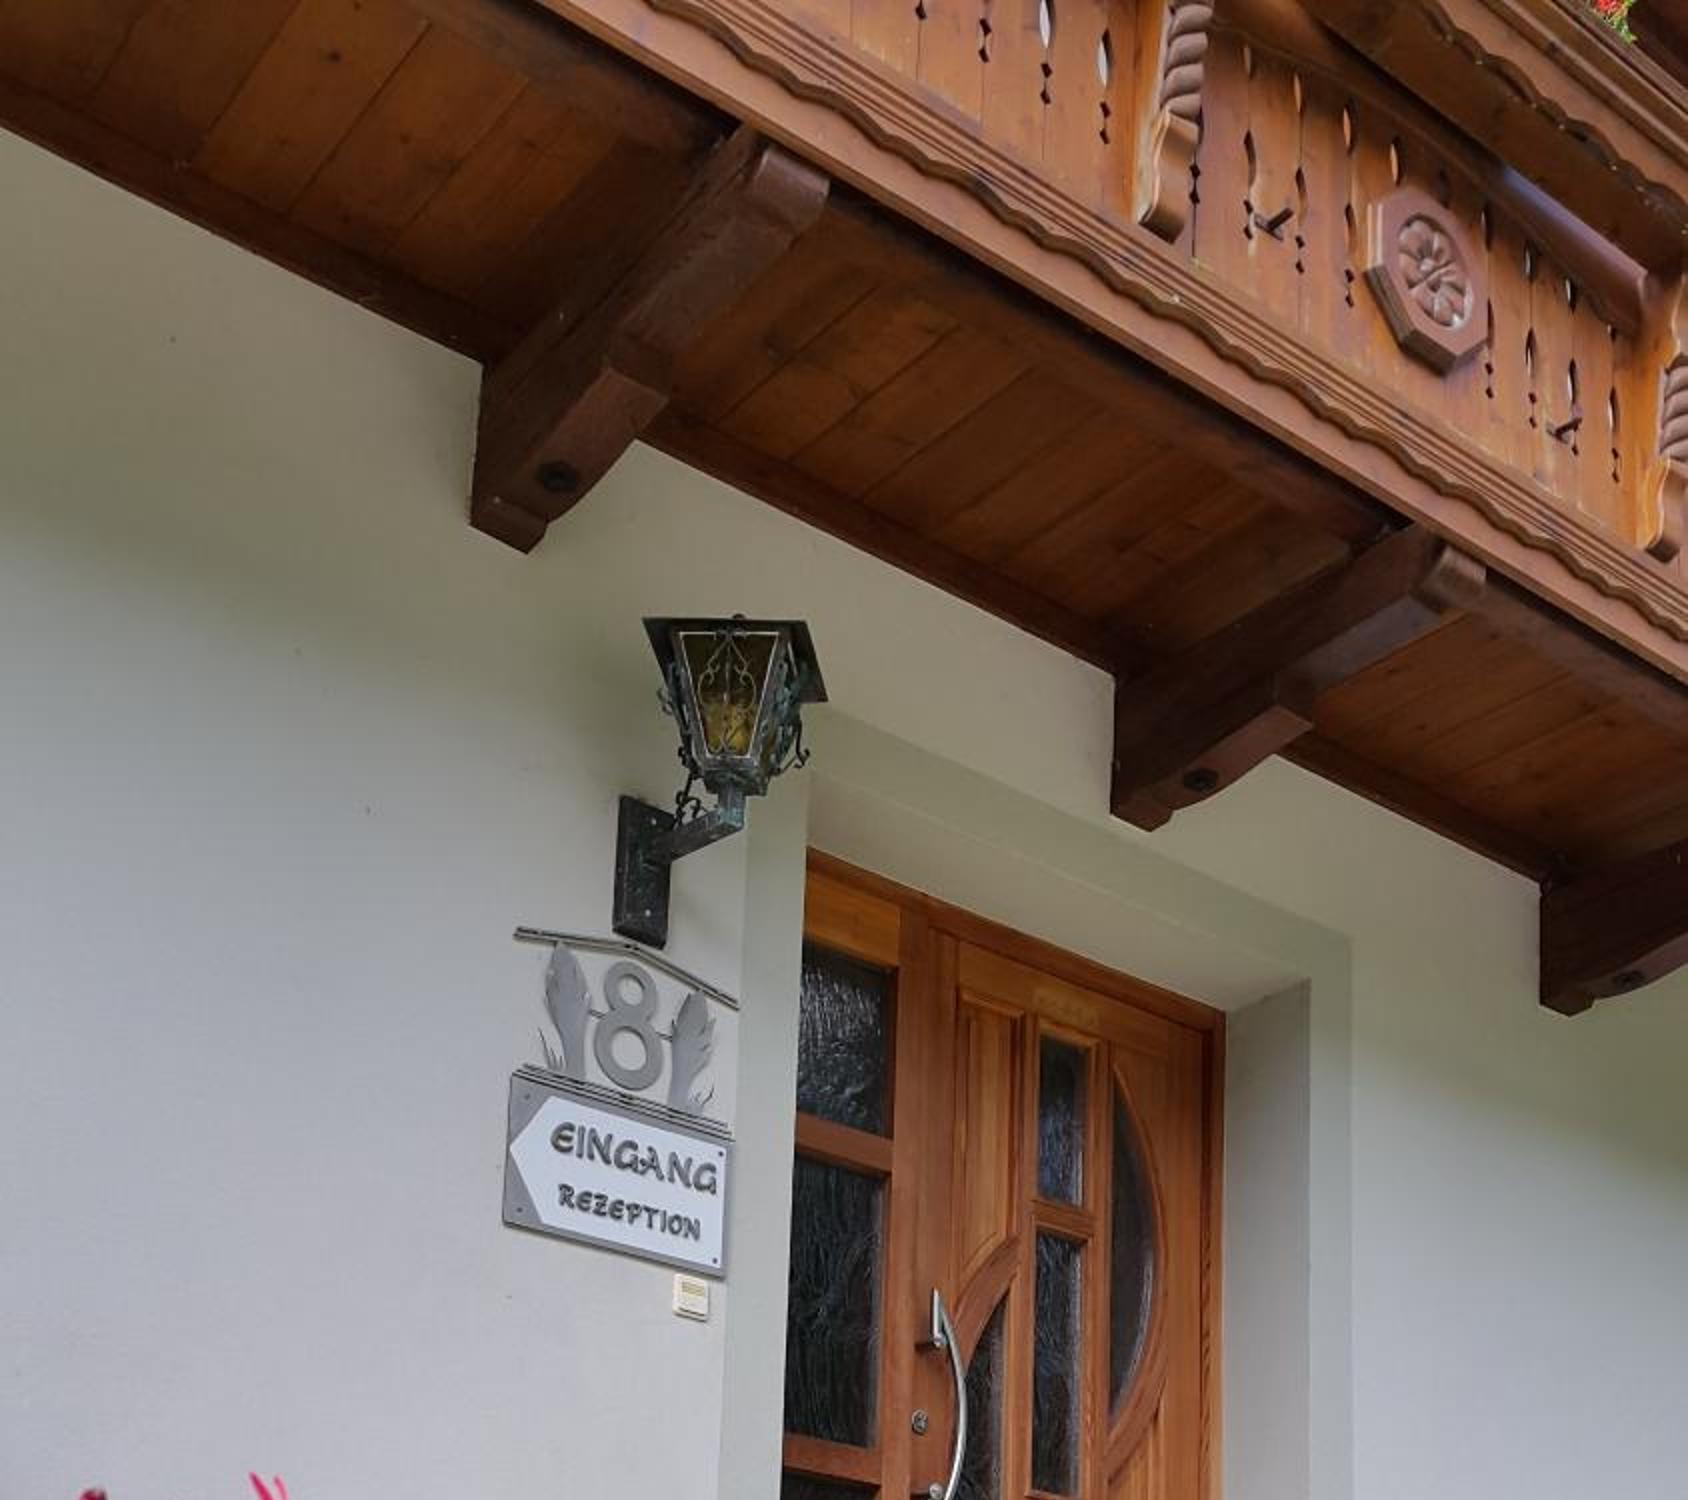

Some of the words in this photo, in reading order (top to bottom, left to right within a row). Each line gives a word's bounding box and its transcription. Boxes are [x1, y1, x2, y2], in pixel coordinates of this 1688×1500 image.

[594, 961, 662, 1091] 8
[550, 1121, 718, 1195] EINGANG
[558, 1183, 701, 1241] REZEPTION
